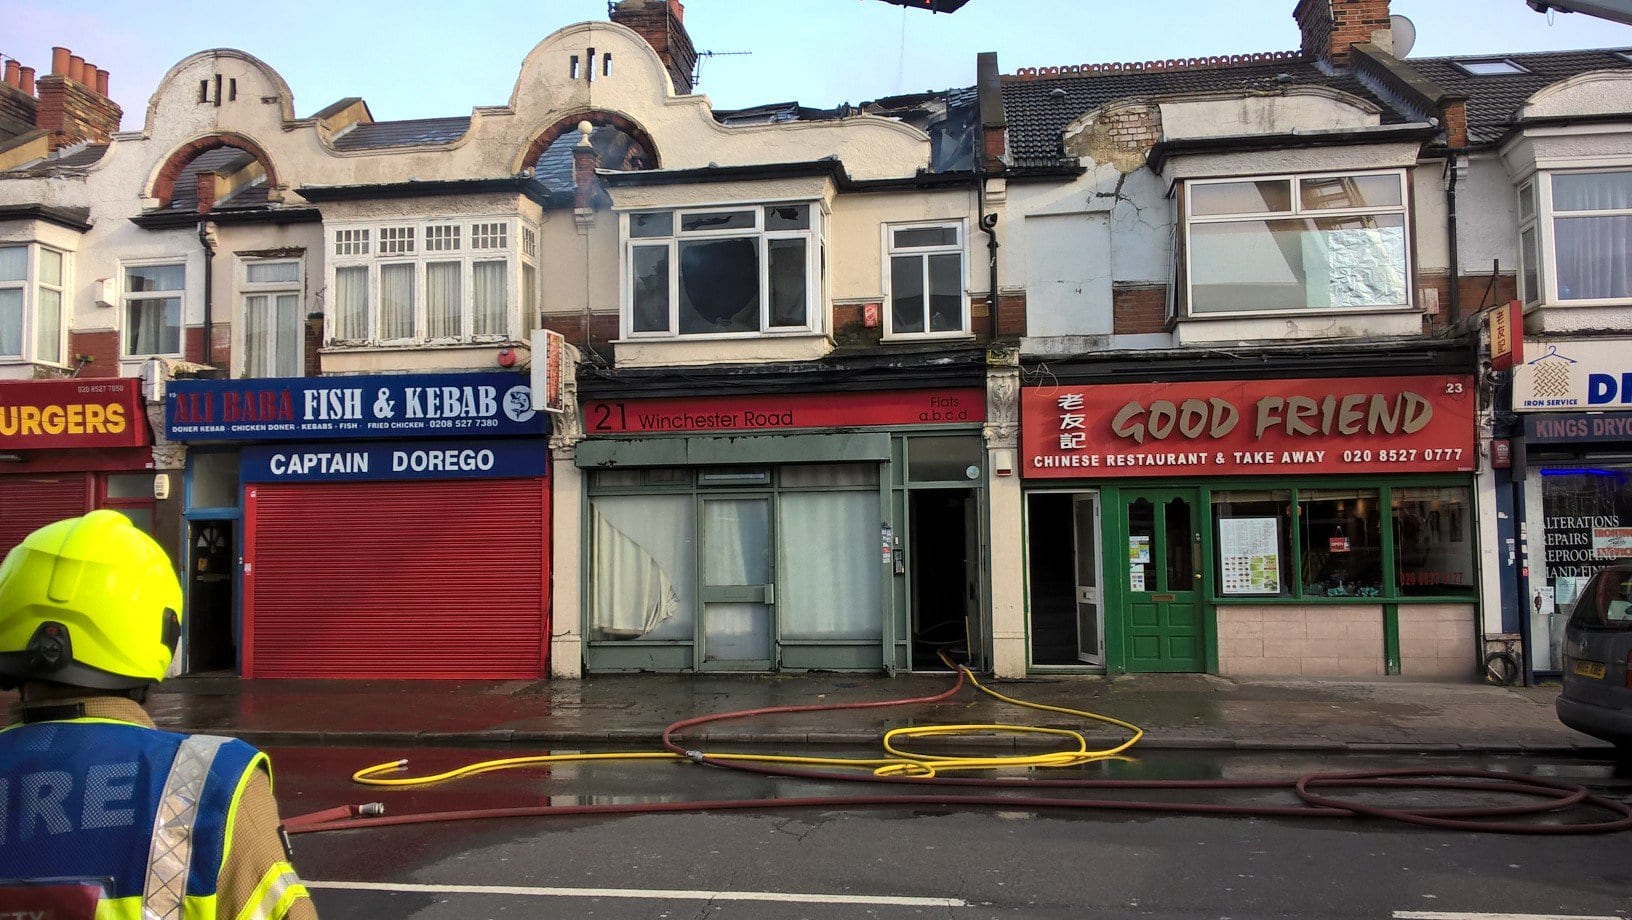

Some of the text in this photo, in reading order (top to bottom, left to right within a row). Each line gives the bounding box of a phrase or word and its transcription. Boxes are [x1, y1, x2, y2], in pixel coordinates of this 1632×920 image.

[1447, 383, 1463, 394] 23
[174, 386, 498, 423] ALI BABA FISH & KEBAB
[930, 396, 959, 408] Flats
[0, 403, 126, 436] URGERS
[172, 425, 198, 433] DONER
[268, 423, 295, 431] DONER
[301, 422, 333, 430] KEBABS
[430, 420, 452, 428] 0208
[476, 419, 498, 427] 7380
[595, 403, 793, 430] 21 Winchester Road
[1057, 393, 1086, 450] 老友記
[1111, 391, 1433, 444] GOOD FRIEND
[1536, 419, 1588, 438] KINGS
[270, 449, 495, 475] CAPTAIN DOREGO
[1034, 448, 1463, 468] CHINESE RESTAURANT & TAKE AWAY 020 8527 0777
